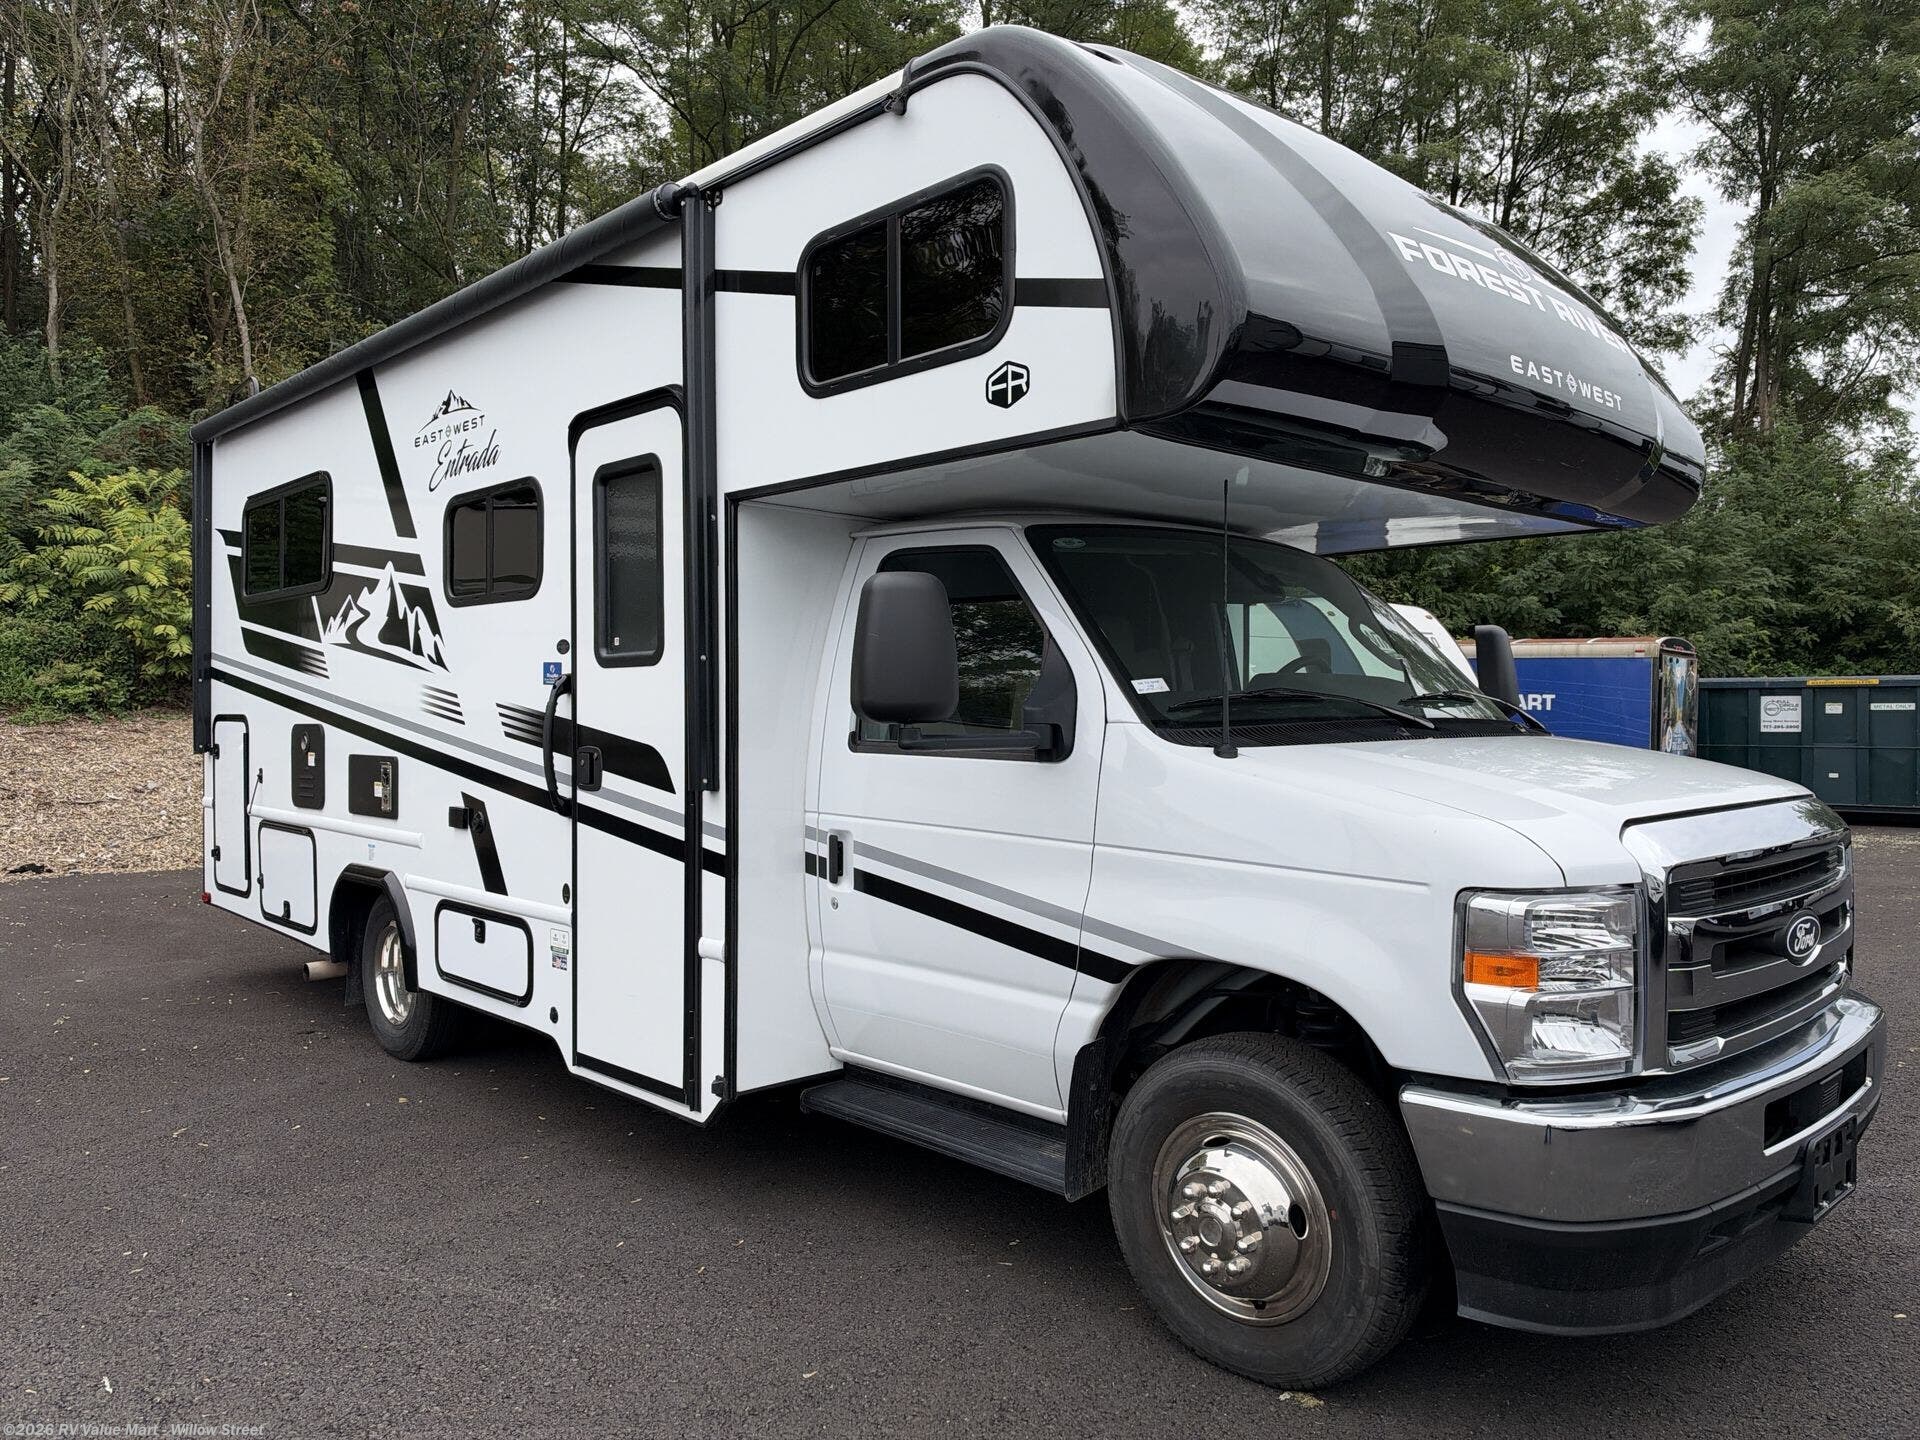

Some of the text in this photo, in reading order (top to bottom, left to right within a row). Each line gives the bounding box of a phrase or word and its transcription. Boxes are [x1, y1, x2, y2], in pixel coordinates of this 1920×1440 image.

[1387, 232, 1546, 312] FOREST
[1510, 354, 1622, 411] EAST WEST
[414, 414, 486, 448] EAST WEST
[428, 429, 501, 492] Entrada
[1794, 922, 1816, 952] Ford
